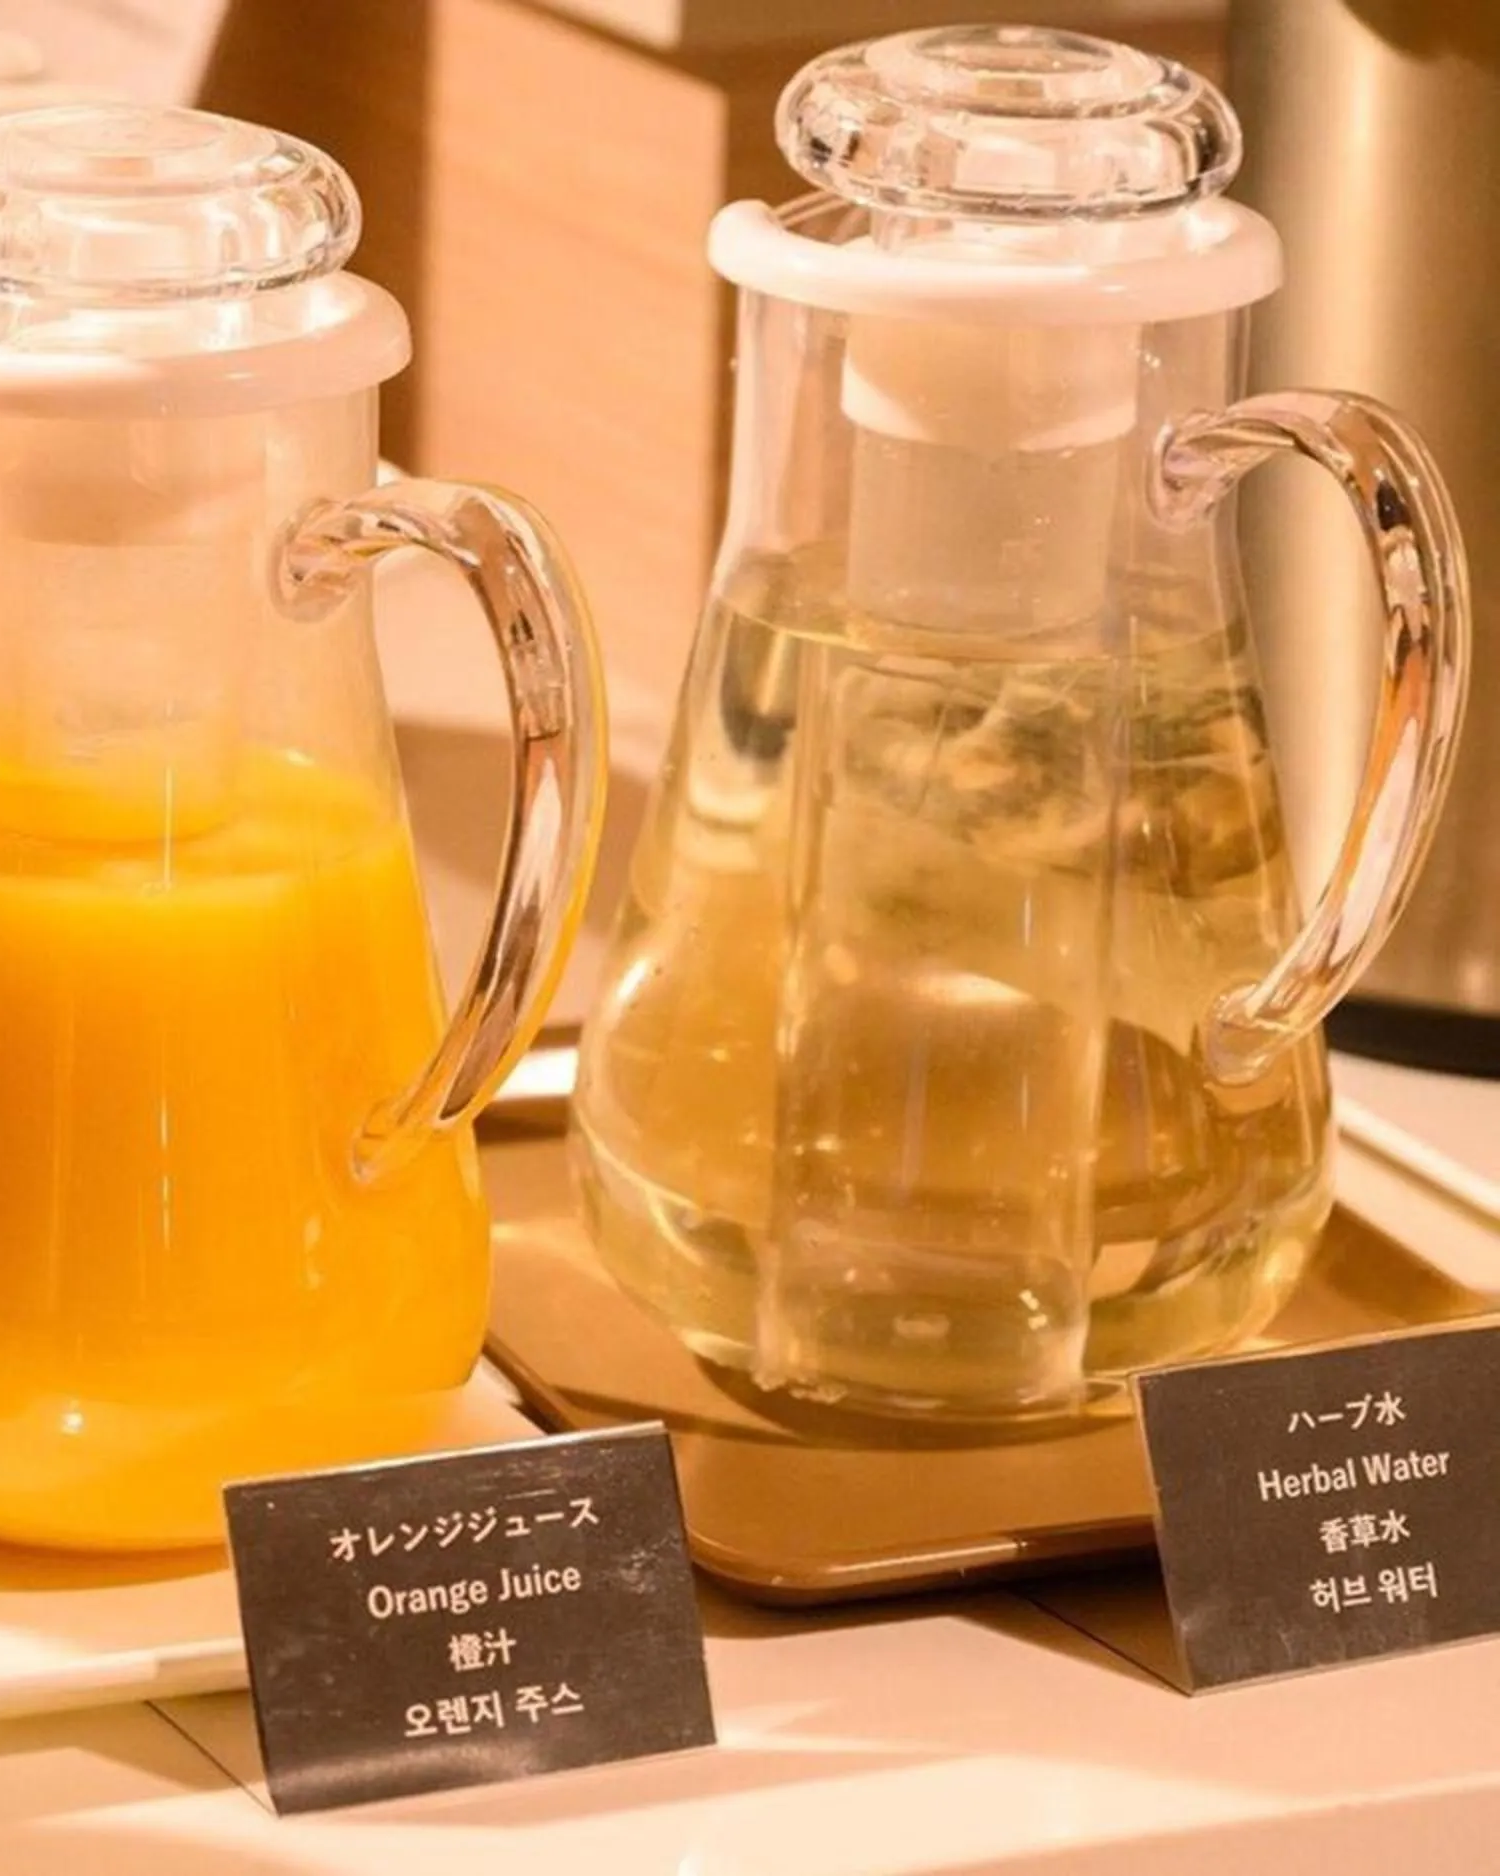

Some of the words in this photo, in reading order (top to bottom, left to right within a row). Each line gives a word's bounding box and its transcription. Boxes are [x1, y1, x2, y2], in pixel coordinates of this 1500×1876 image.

[1288, 1391, 1406, 1433] ハーブ水
[1257, 1458, 1357, 1501] Herbal
[1361, 1451, 1450, 1485] Water
[330, 1497, 599, 1562] オレンジジュース
[1319, 1509, 1410, 1554] 香草水
[367, 1578, 488, 1619] Orange
[499, 1563, 581, 1601] Juice
[1309, 1575, 1372, 1613] 허브
[1378, 1562, 1438, 1604] 워터
[448, 1628, 517, 1672] 橙汁
[405, 1690, 505, 1737] 오렌지
[515, 1682, 584, 1723] 주스
